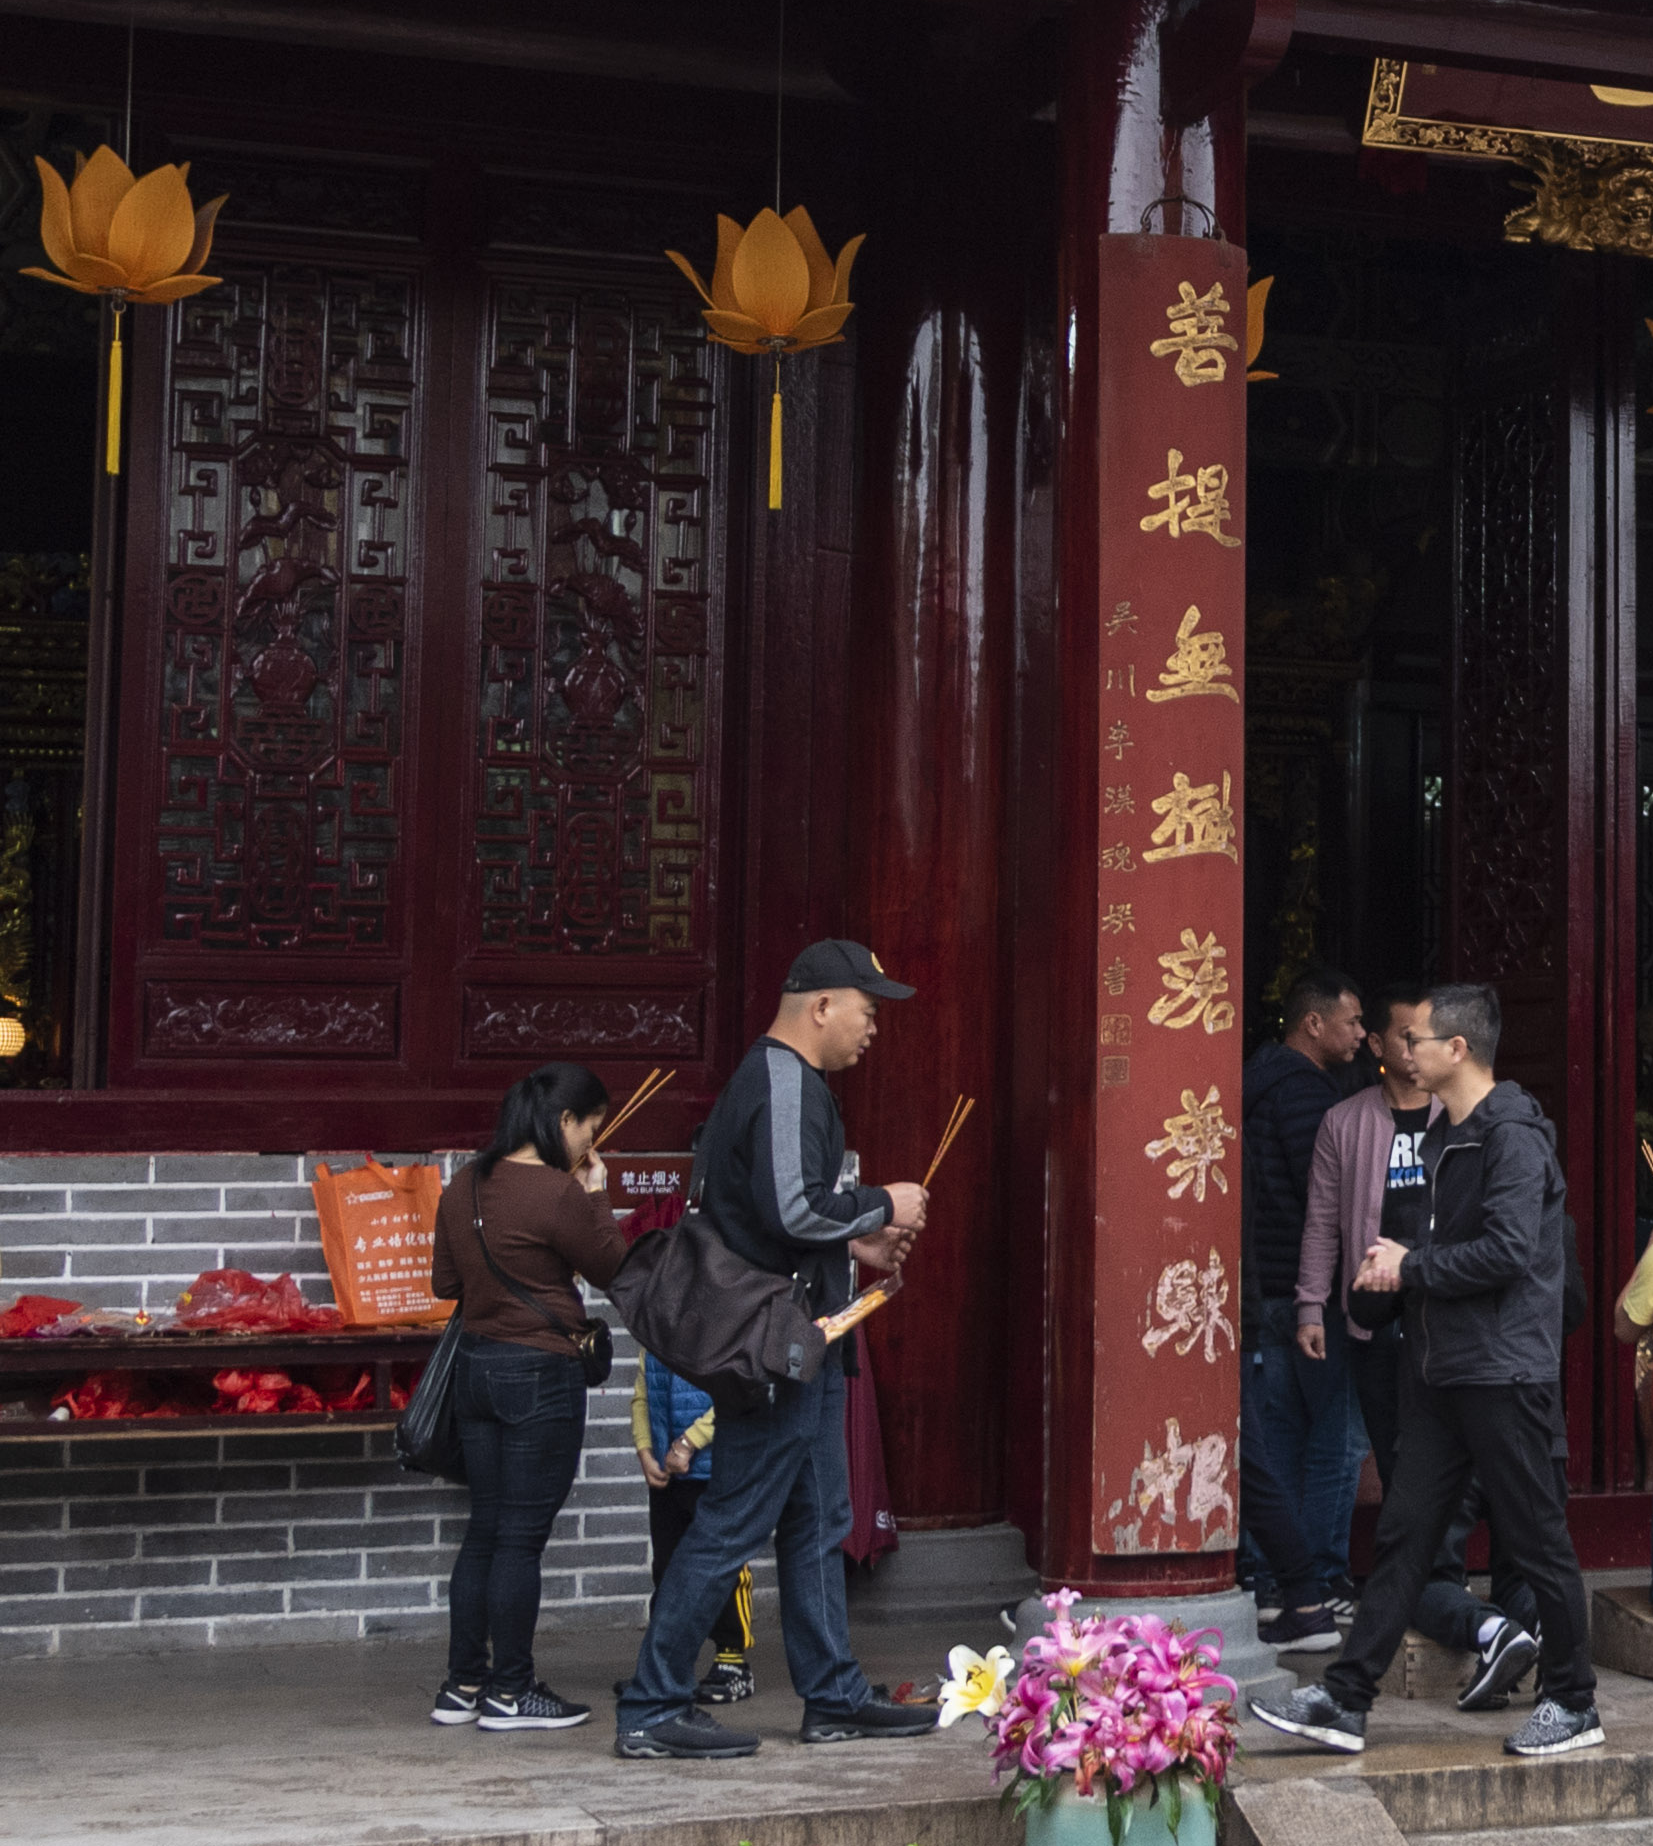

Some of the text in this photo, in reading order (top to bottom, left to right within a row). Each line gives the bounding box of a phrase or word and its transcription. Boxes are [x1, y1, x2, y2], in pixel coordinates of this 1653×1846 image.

[621, 1170, 680, 1186] 禁止烟火
[627, 1186, 639, 1194] NO
